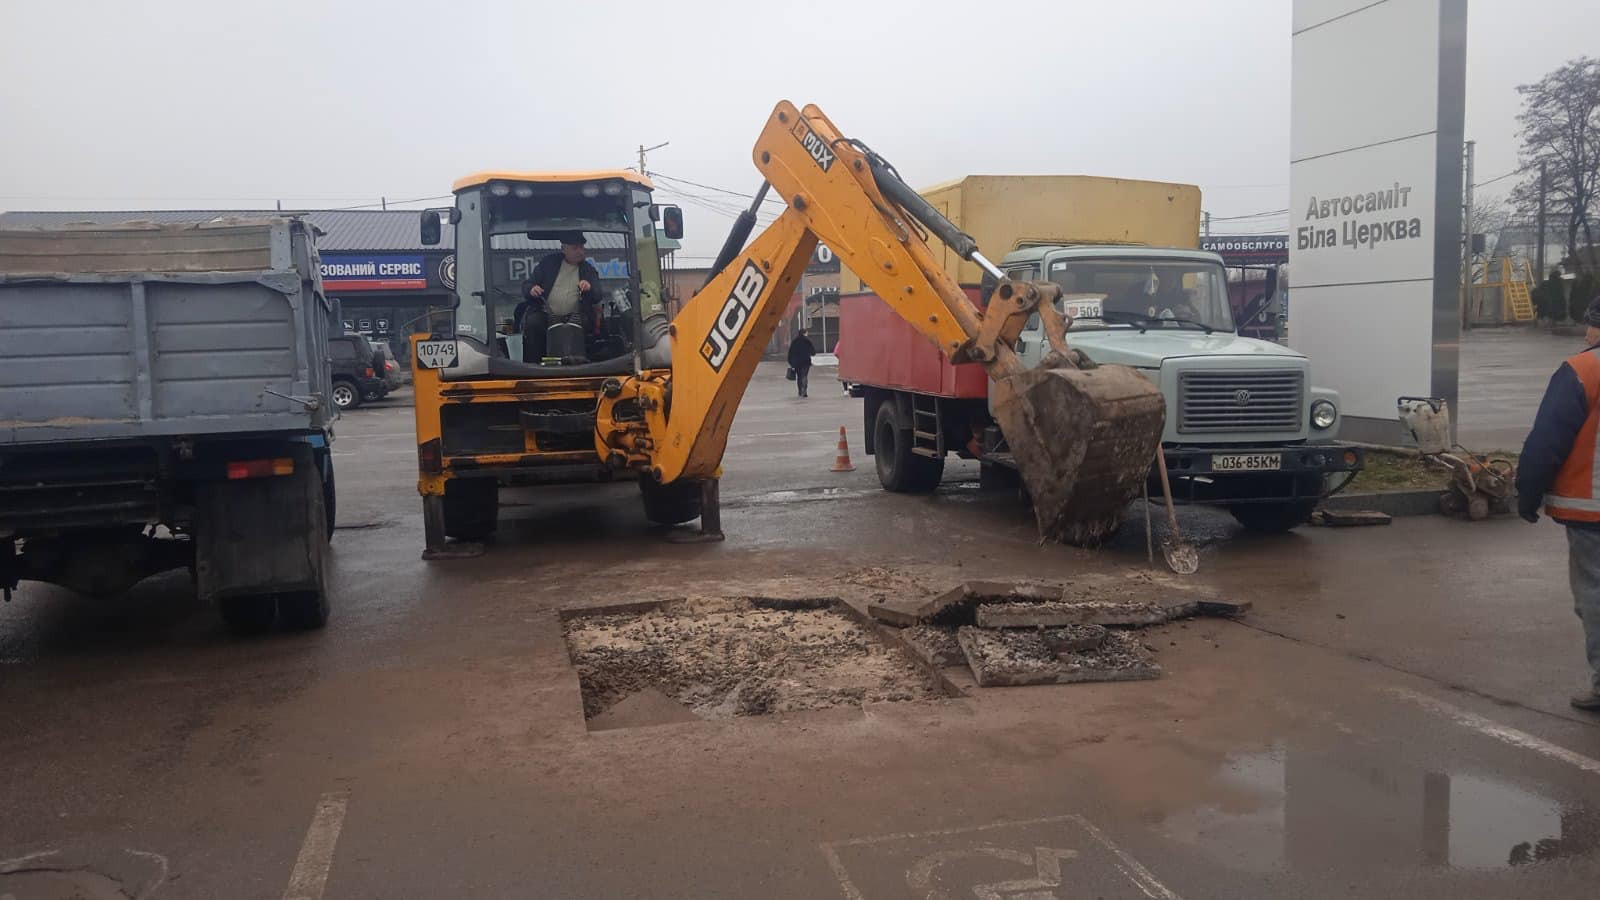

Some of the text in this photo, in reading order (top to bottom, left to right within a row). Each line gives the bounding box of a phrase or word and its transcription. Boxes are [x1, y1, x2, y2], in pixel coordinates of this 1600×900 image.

[1305, 182, 1411, 220] Автосаміт
[1297, 218, 1421, 250] Біла Церква
[379, 263, 421, 275] СЕРВІС
[709, 265, 764, 367] JCB
[1079, 306, 1100, 318] 509
[420, 344, 454, 356] 10749
[1222, 456, 1279, 469] 036-85KM
